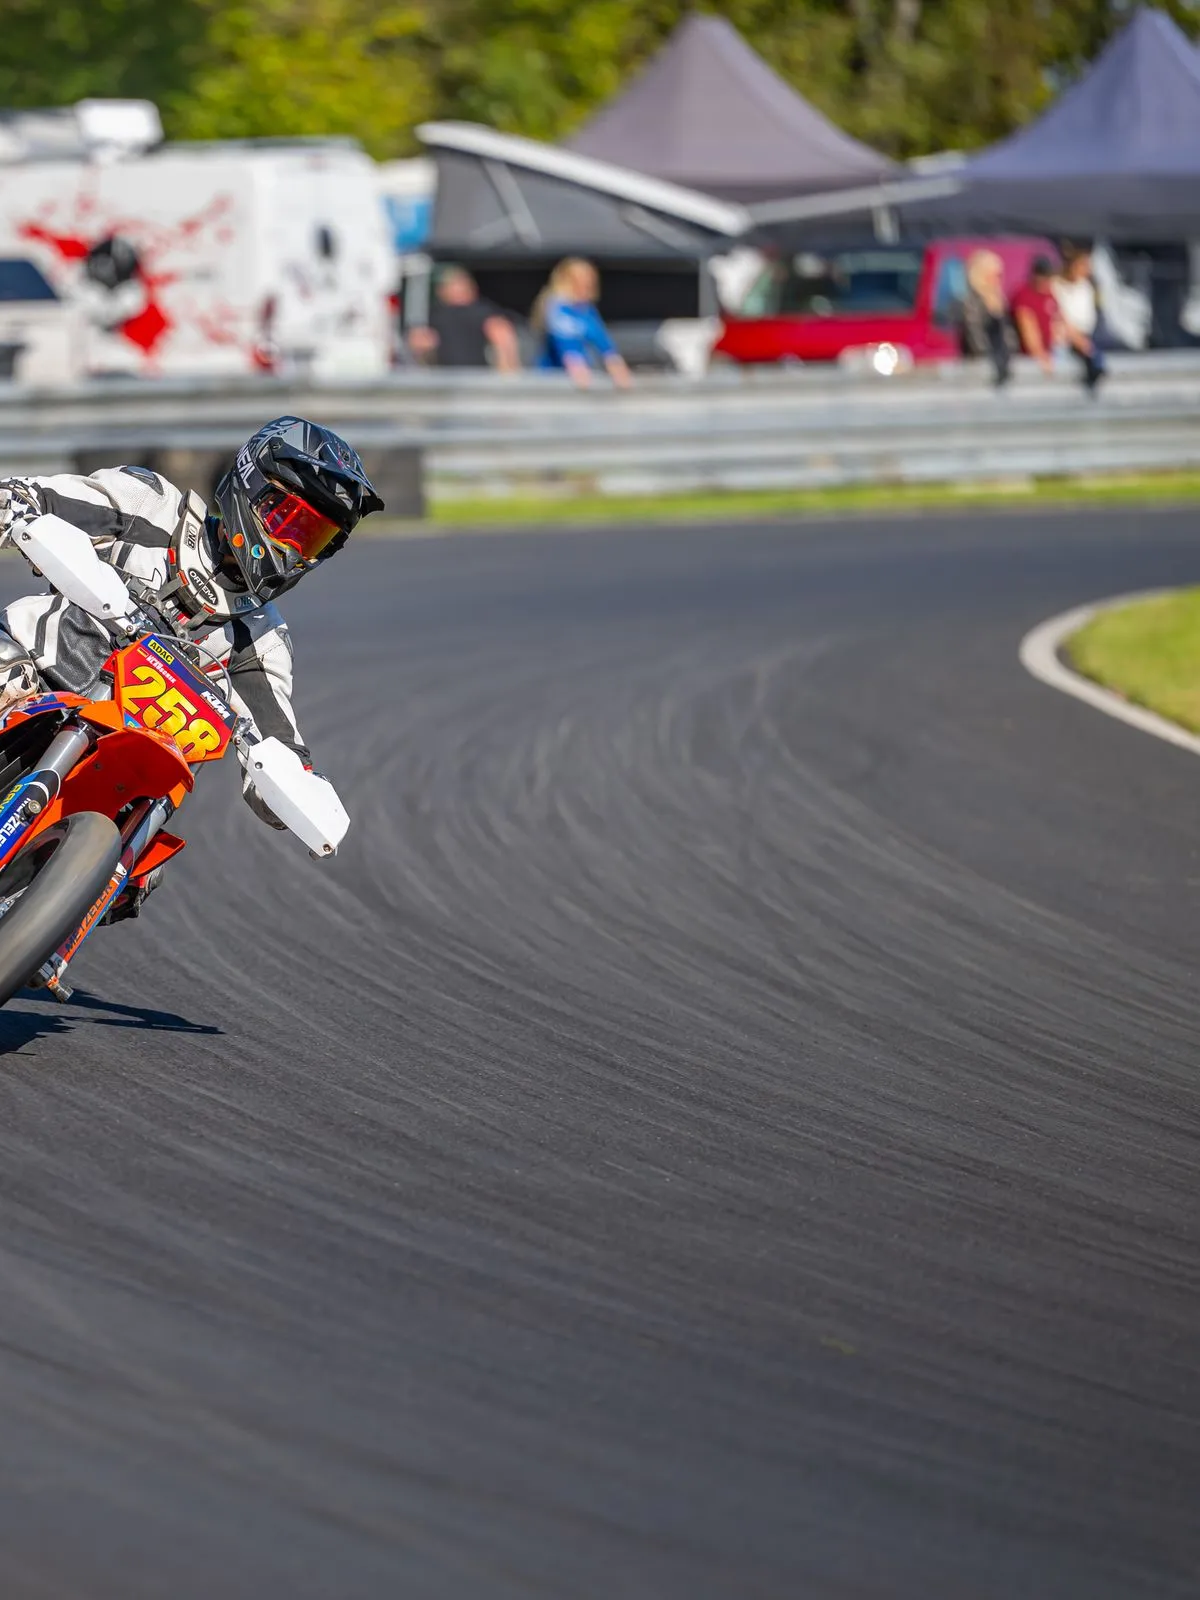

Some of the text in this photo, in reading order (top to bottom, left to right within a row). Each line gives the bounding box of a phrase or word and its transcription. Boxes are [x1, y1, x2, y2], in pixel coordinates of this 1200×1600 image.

[189, 570, 217, 604] ORTEMA
[149, 641, 174, 663] ADAC
[121, 665, 221, 760] 258
[201, 690, 231, 719] KTM
